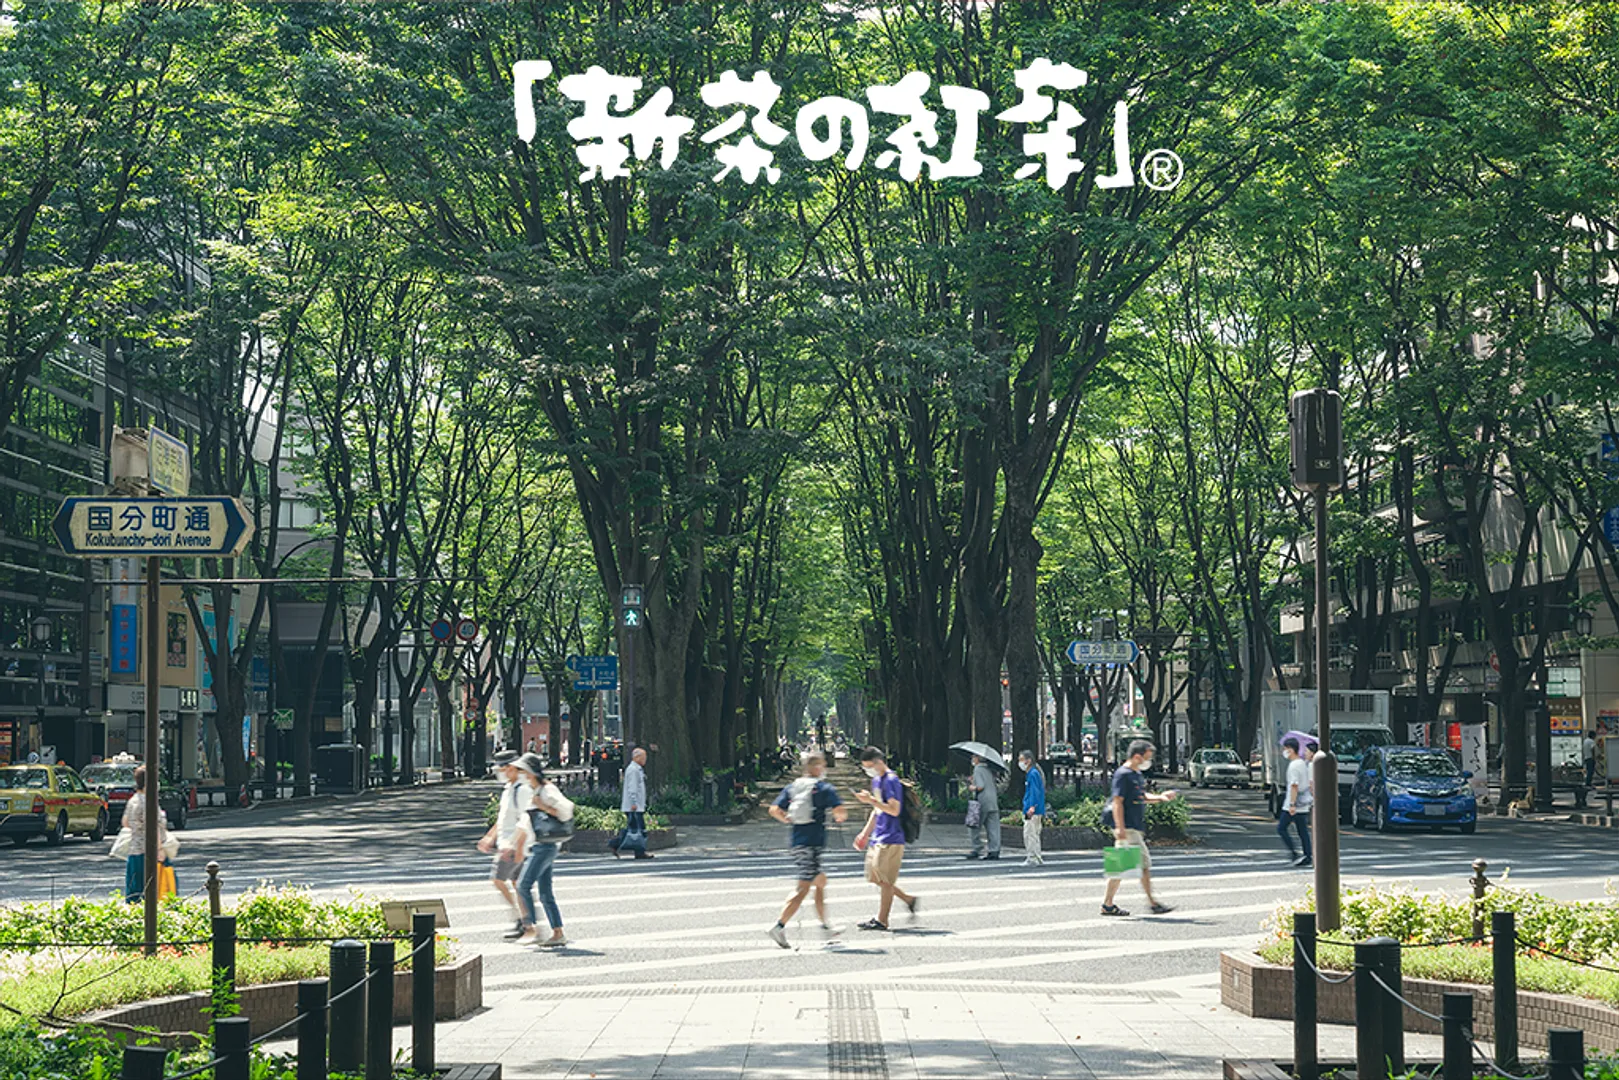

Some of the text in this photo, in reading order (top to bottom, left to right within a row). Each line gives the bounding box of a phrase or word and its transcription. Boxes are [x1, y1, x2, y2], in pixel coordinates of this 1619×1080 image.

[88, 506, 210, 531] 国分町通
[85, 533, 212, 547] Kokubuncho-dori Avenue
[461, 624, 474, 635] 40
